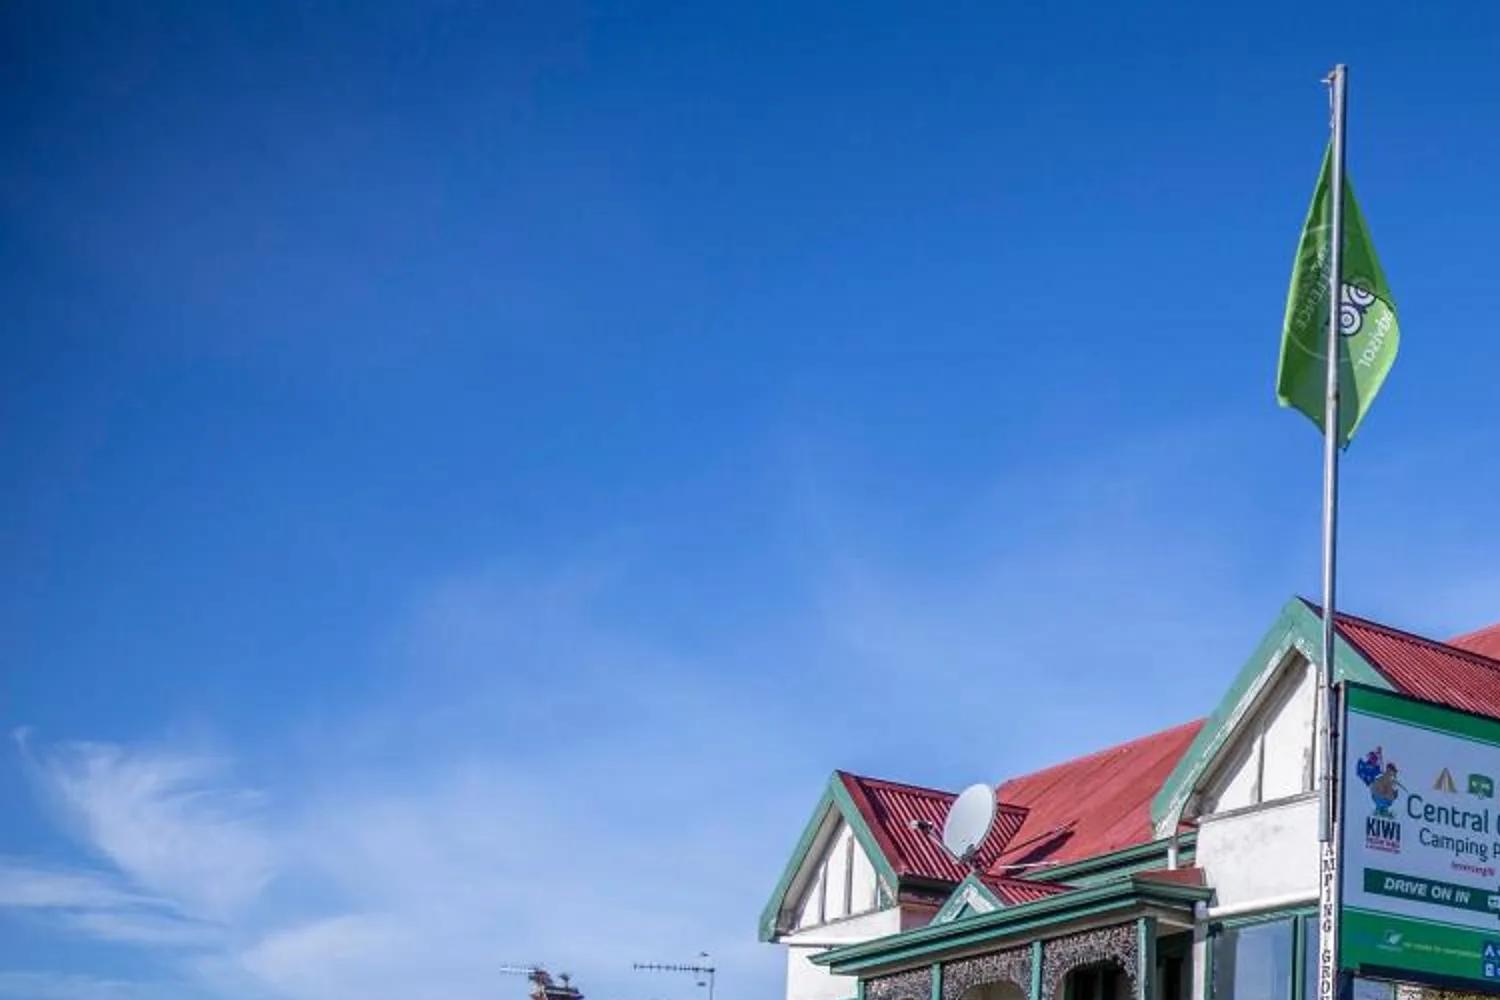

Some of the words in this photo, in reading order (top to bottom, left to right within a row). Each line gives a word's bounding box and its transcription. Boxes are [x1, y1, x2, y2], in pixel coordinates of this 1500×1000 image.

[1366, 816, 1401, 842] KIWI
[1407, 794, 1489, 834] Central
[1419, 827, 1489, 863] Camping
[1321, 843, 1336, 933] AMPING
[1384, 877, 1428, 897] DRIVE
[1431, 885, 1453, 899] ON
[1455, 889, 1472, 905] IN
